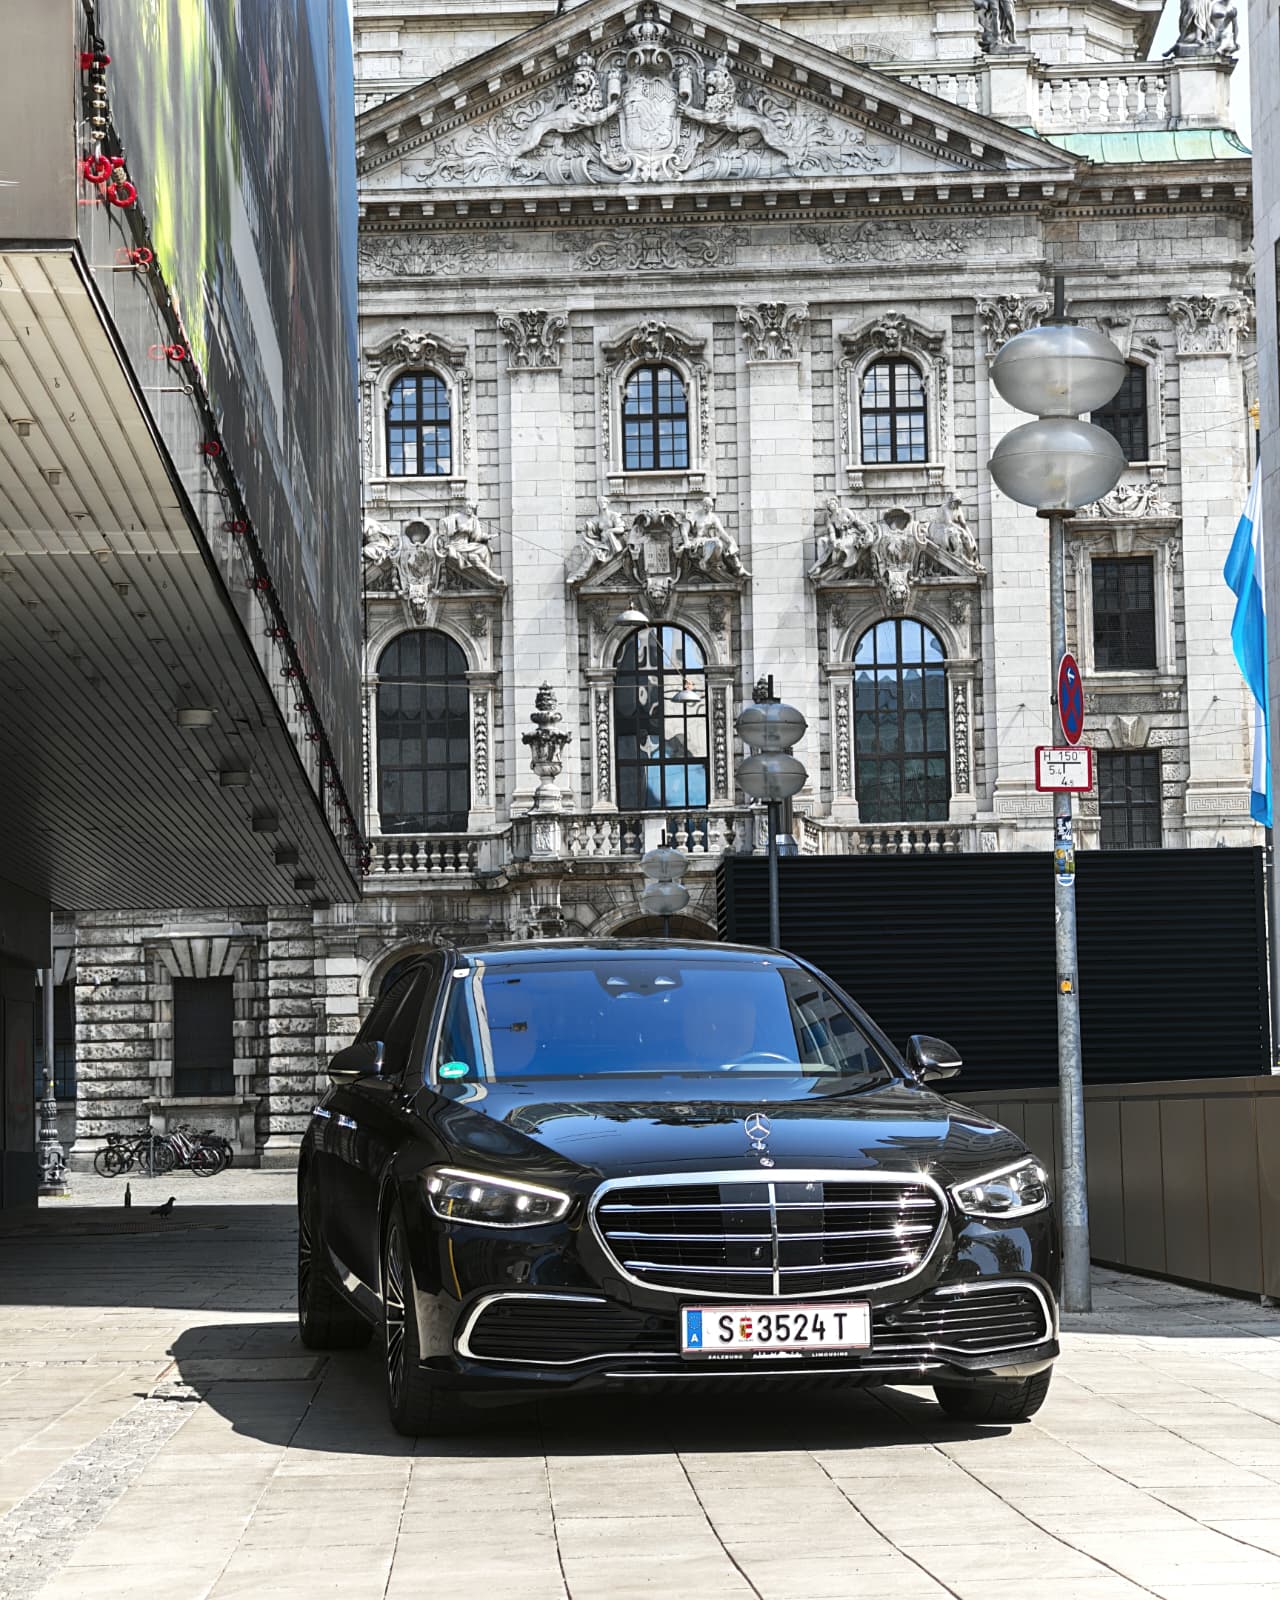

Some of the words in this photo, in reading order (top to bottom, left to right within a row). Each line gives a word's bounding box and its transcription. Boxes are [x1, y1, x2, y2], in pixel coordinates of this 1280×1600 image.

[1043, 751, 1051, 761] H
[1058, 751, 1078, 761] 150
[718, 1315, 734, 1342] S
[690, 1333, 698, 1342] A
